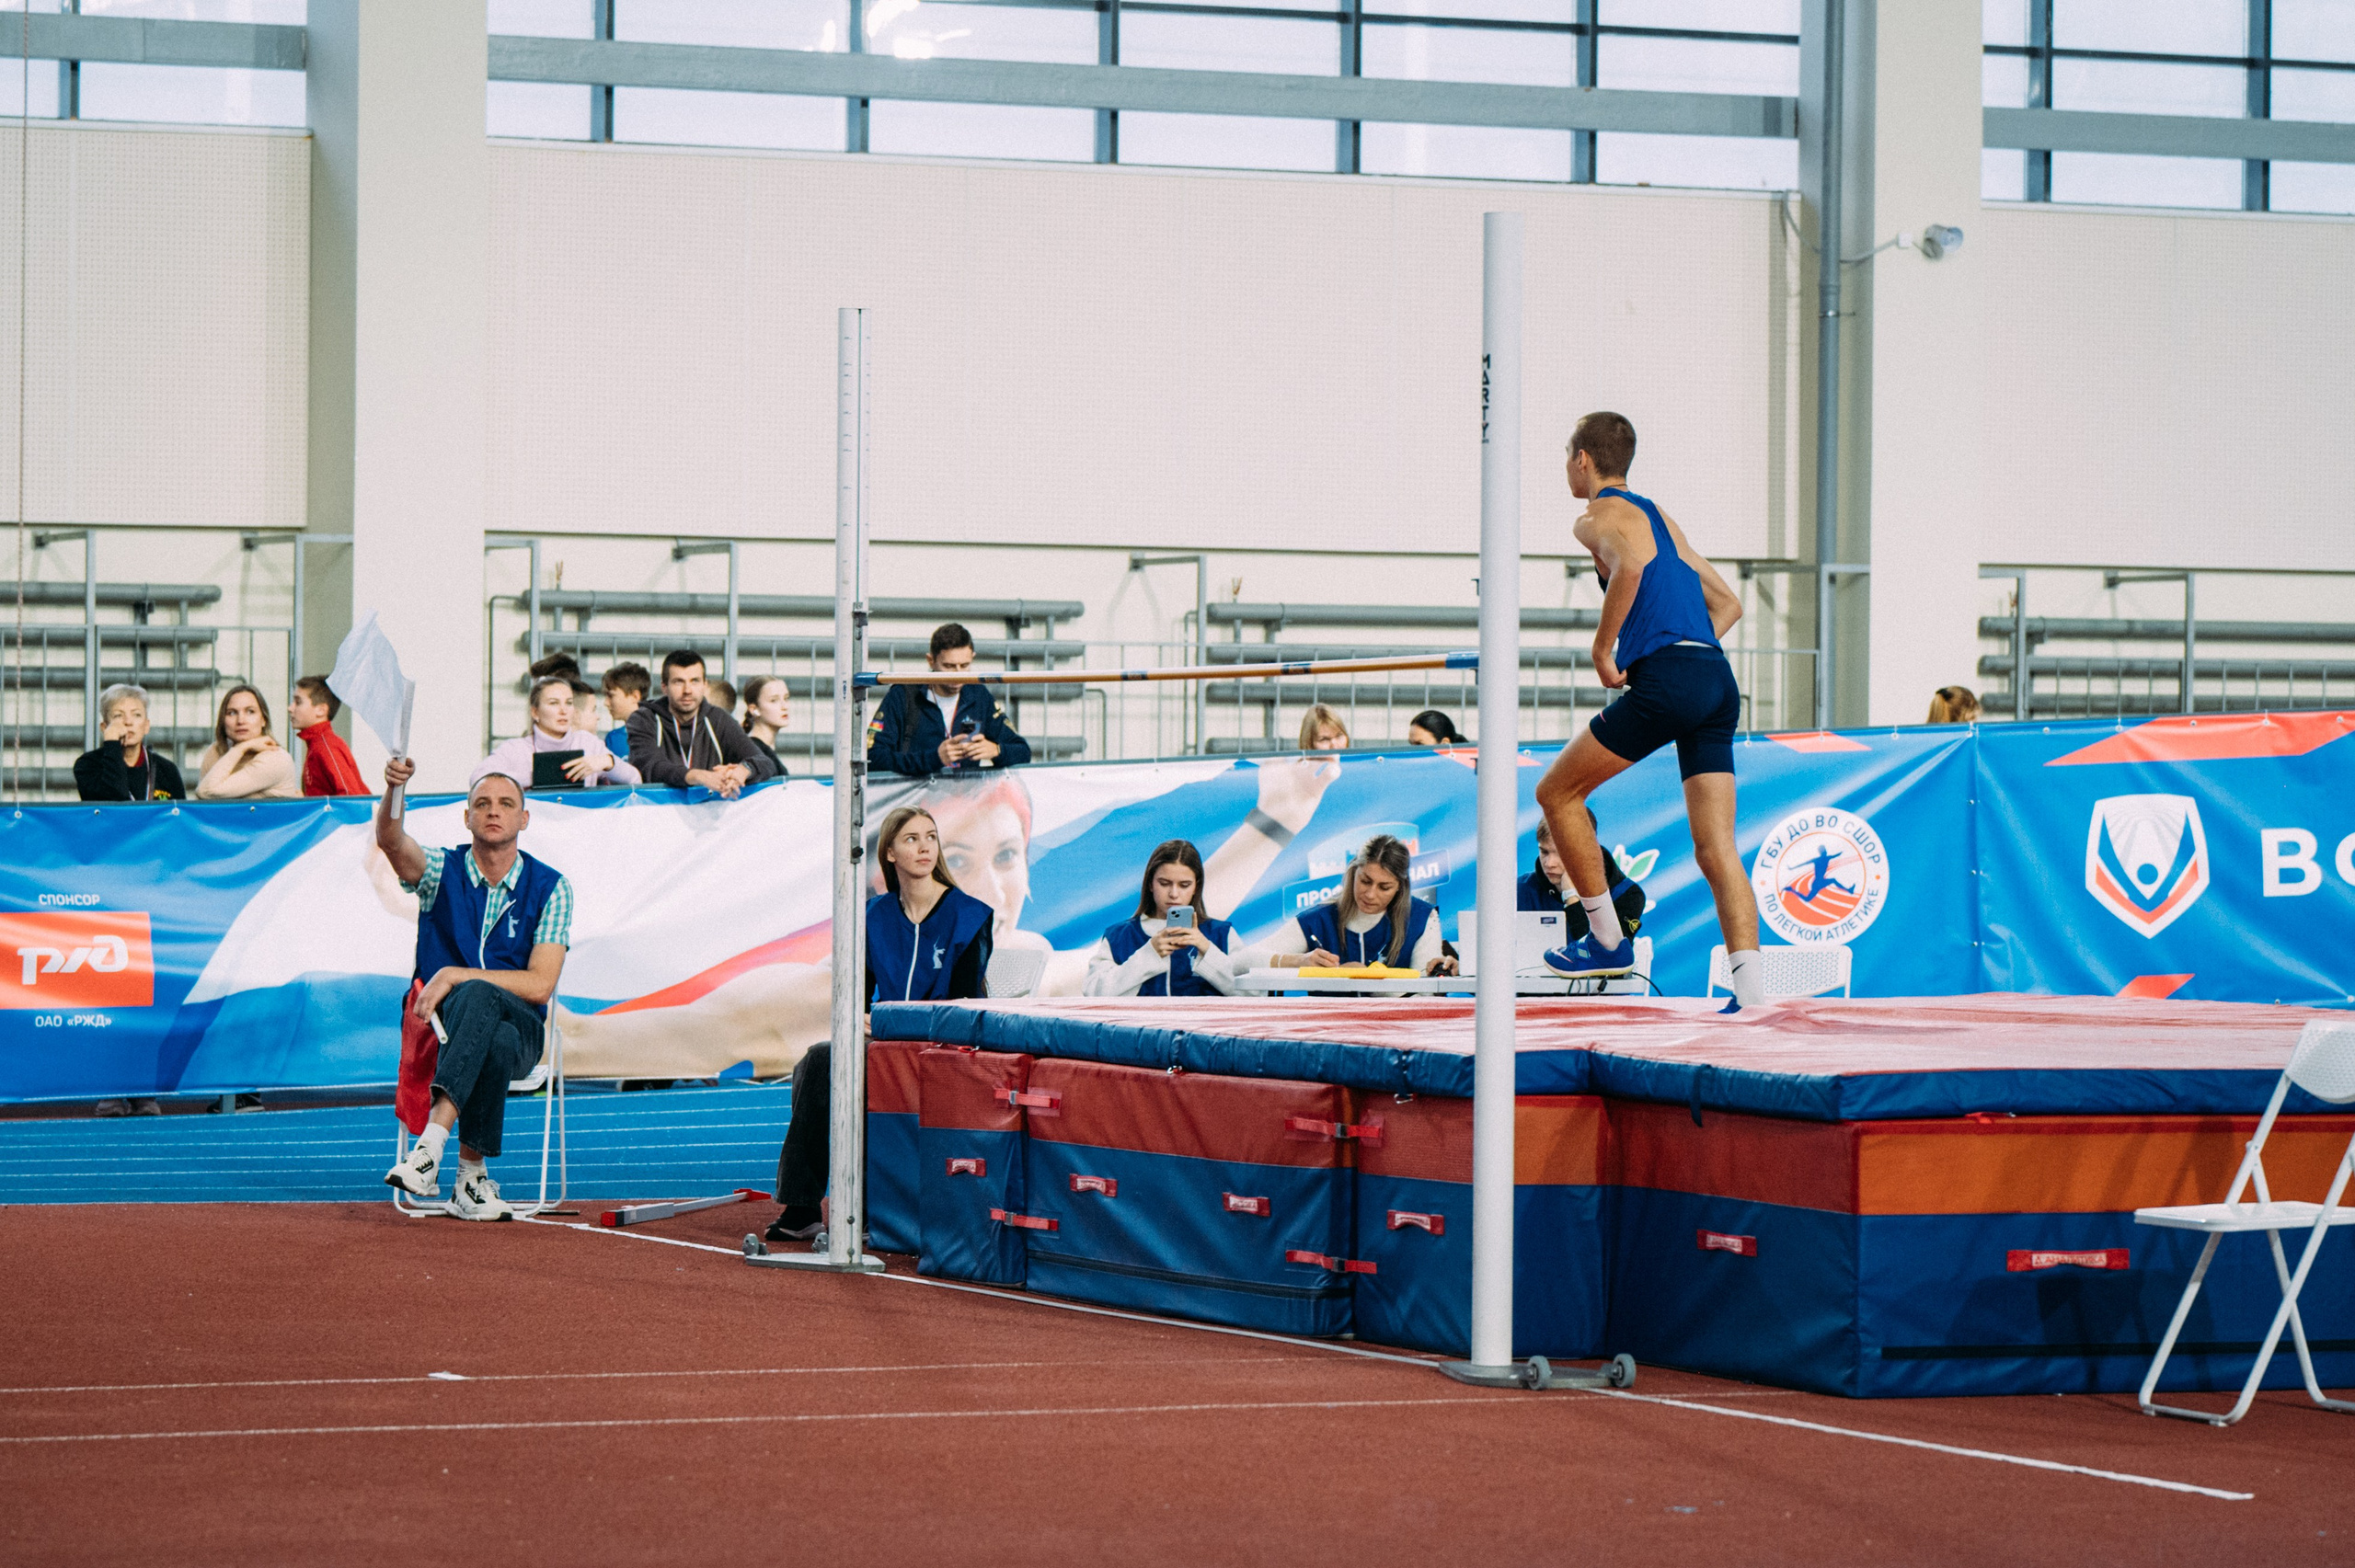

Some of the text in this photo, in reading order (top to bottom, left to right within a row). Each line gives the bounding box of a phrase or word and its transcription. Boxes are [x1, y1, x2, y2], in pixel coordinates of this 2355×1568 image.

[1760, 815, 1881, 869] ГБУ ДО ВО СШОР
[39, 894, 100, 906] СПОНСОР
[1763, 888, 1879, 941] ПО ЛЕГКОЙ АТЛЕТИКЕ
[35, 1014, 112, 1028] ОАО «РЖД»
